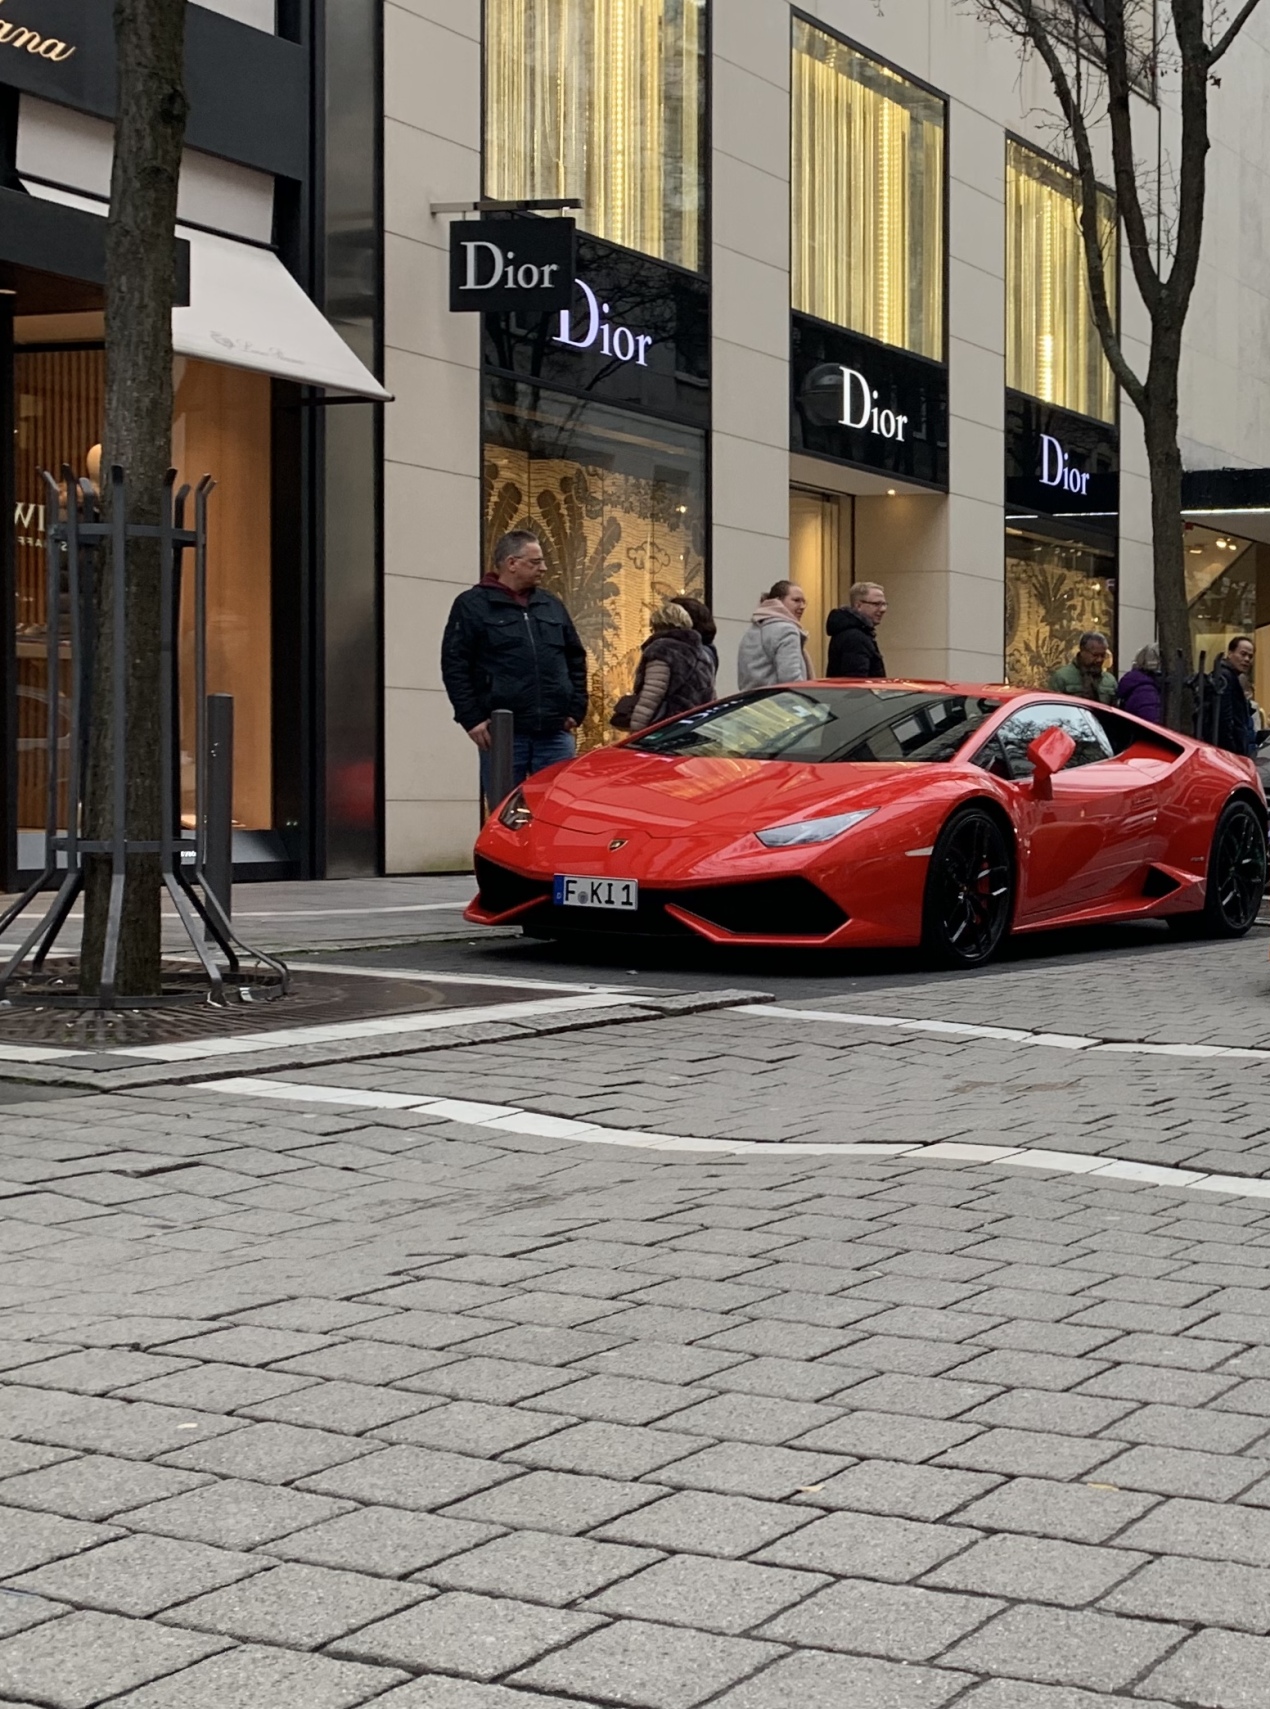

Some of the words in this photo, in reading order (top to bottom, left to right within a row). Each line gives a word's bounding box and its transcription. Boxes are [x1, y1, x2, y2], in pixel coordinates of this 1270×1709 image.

[459, 241, 559, 289] Dior
[552, 278, 652, 366] Dior
[838, 366, 908, 442] Dior
[1040, 434, 1090, 495] Dior
[565, 880, 577, 901] F
